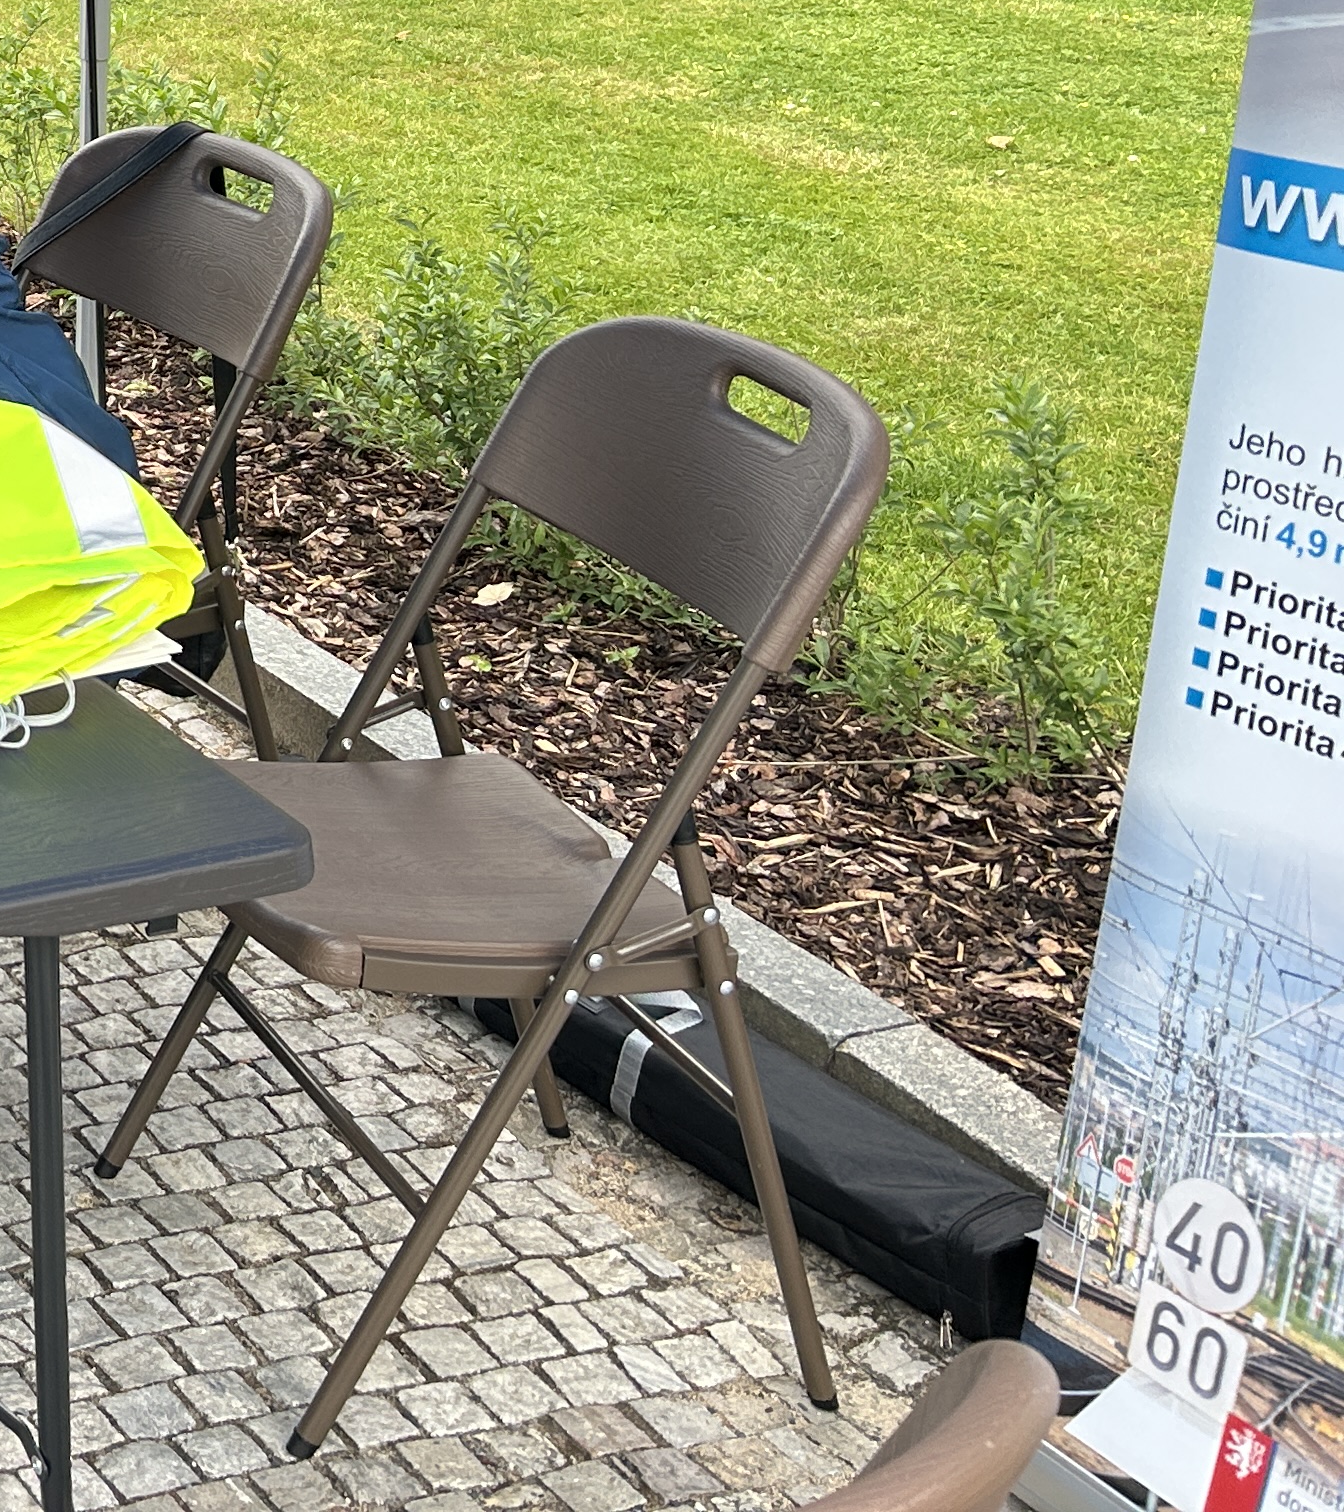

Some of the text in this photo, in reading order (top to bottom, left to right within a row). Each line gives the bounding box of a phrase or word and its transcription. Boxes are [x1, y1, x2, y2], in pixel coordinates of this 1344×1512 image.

[1229, 422, 1306, 466] Jeho
[1216, 501, 1272, 543] činí
[1275, 521, 1328, 559] 4,9
[1223, 609, 1344, 676] Priorita
[1216, 649, 1341, 718] Priorita
[1210, 689, 1335, 759] Priorita
[1165, 1201, 1251, 1295] 40
[1145, 1300, 1228, 1400] 60
